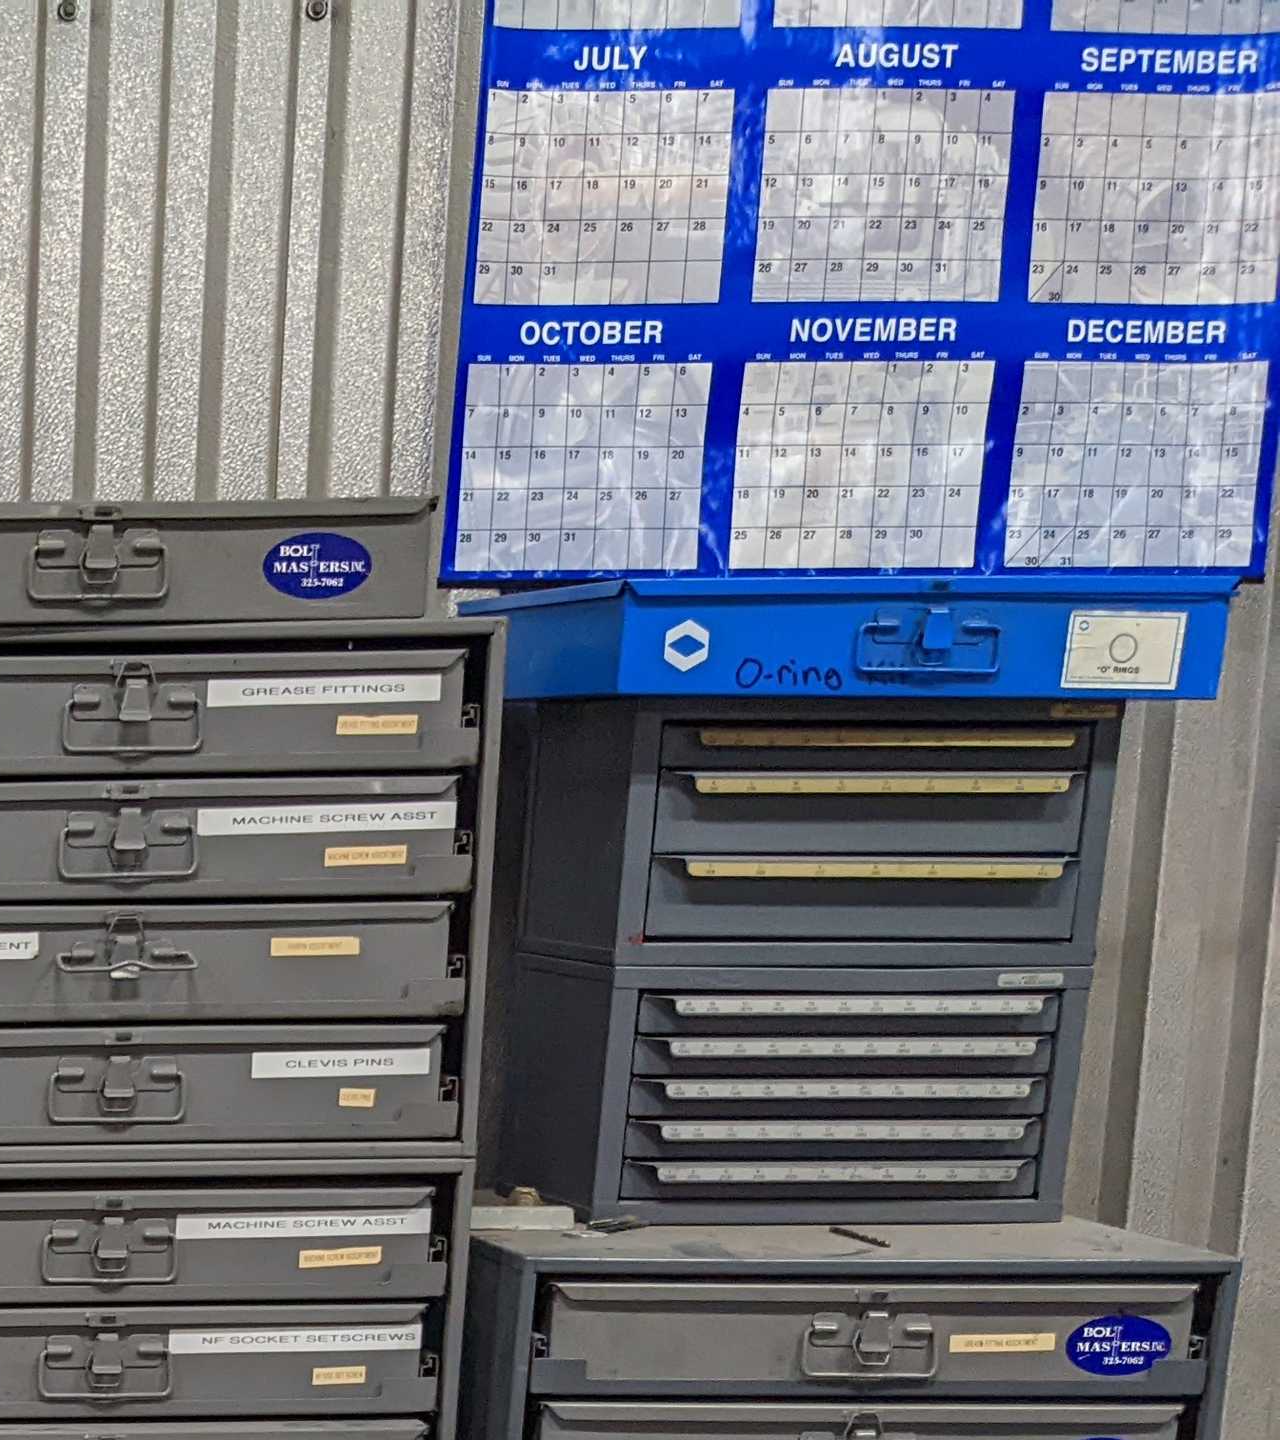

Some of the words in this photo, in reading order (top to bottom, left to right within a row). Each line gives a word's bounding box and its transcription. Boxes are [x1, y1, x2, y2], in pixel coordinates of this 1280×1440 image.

[574, 46, 648, 71] JULY
[836, 43, 959, 69] AUGUST
[1081, 47, 1258, 75] SEPTEMBER
[554, 138, 565, 147] 10
[627, 136, 638, 146] 12
[513, 223, 525, 233] 23
[693, 222, 706, 231] 28
[869, 221, 882, 230] 22
[544, 266, 556, 276] 31
[900, 263, 913, 273] 30
[1066, 265, 1079, 275] 24
[520, 320, 663, 346] OCTOBER
[790, 317, 957, 342] NOVEMBER
[1067, 319, 1227, 344] DECEMBER
[568, 450, 580, 459] 17
[806, 489, 819, 498] 20
[494, 533, 507, 543] 29
[1077, 529, 1090, 539] 25
[301, 578, 344, 588] 325-7062
[735, 658, 842, 692] O-ring
[241, 685, 315, 698] GREASE
[322, 683, 406, 695] FITTINGS
[231, 815, 313, 827] MACHINE
[320, 812, 384, 824] SCREW
[391, 811, 438, 822] ASST
[285, 1059, 347, 1069] CLEVIS
[353, 1057, 394, 1067] PINS
[207, 1220, 288, 1230] MACHINE
[293, 1218, 357, 1229] SCREW
[363, 1216, 406, 1227] ASST
[202, 1336, 224, 1345] NF
[229, 1335, 299, 1345] SOCKET
[304, 1332, 417, 1343] SETSCREWS
